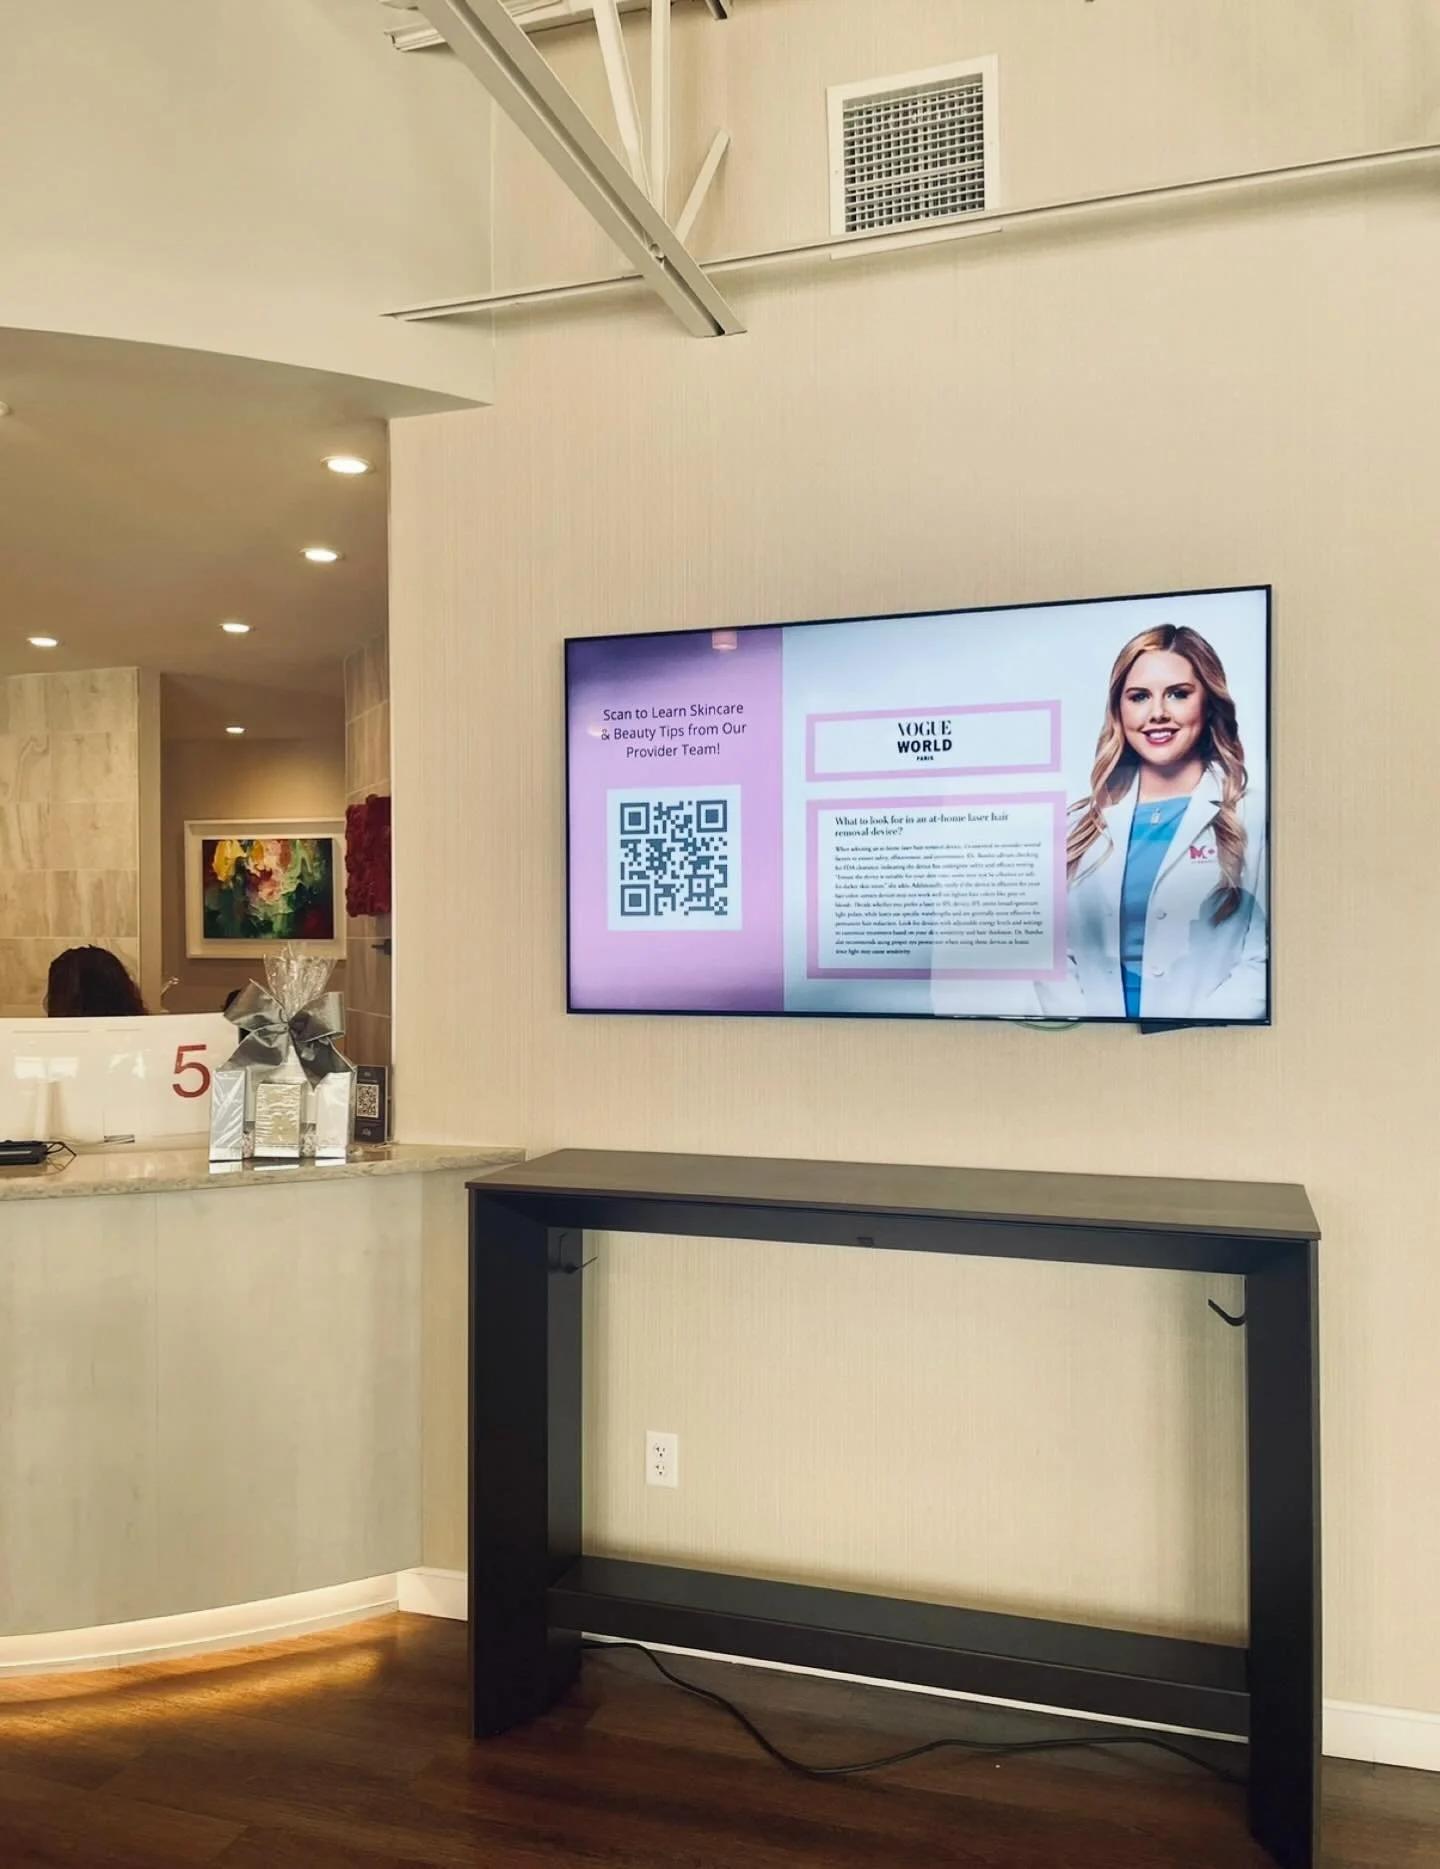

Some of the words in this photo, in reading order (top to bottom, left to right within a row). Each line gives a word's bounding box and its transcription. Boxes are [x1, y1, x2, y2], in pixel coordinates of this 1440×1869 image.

[603, 709, 632, 721] Scan
[635, 709, 648, 719] to
[651, 707, 687, 719] Learn
[690, 704, 744, 717] Skincare
[601, 729, 610, 741] &
[614, 727, 656, 742] Beauty
[659, 725, 685, 740] Tips
[688, 723, 719, 736] from
[721, 722, 747, 735] Our
[898, 720, 952, 736] VOGUE
[626, 745, 678, 758] Provider
[681, 742, 721, 756] Team!
[897, 738, 952, 754] WORLD
[835, 816, 857, 825] What
[859, 817, 868, 825] to
[869, 815, 889, 825] look
[891, 815, 903, 824] for
[905, 815, 915, 824] in
[928, 813, 966, 823] at-home
[967, 812, 990, 822] laser
[991, 811, 1009, 821] hair
[835, 827, 869, 837] removal
[871, 826, 903, 836] device?
[172, 1044, 211, 1098] 5
